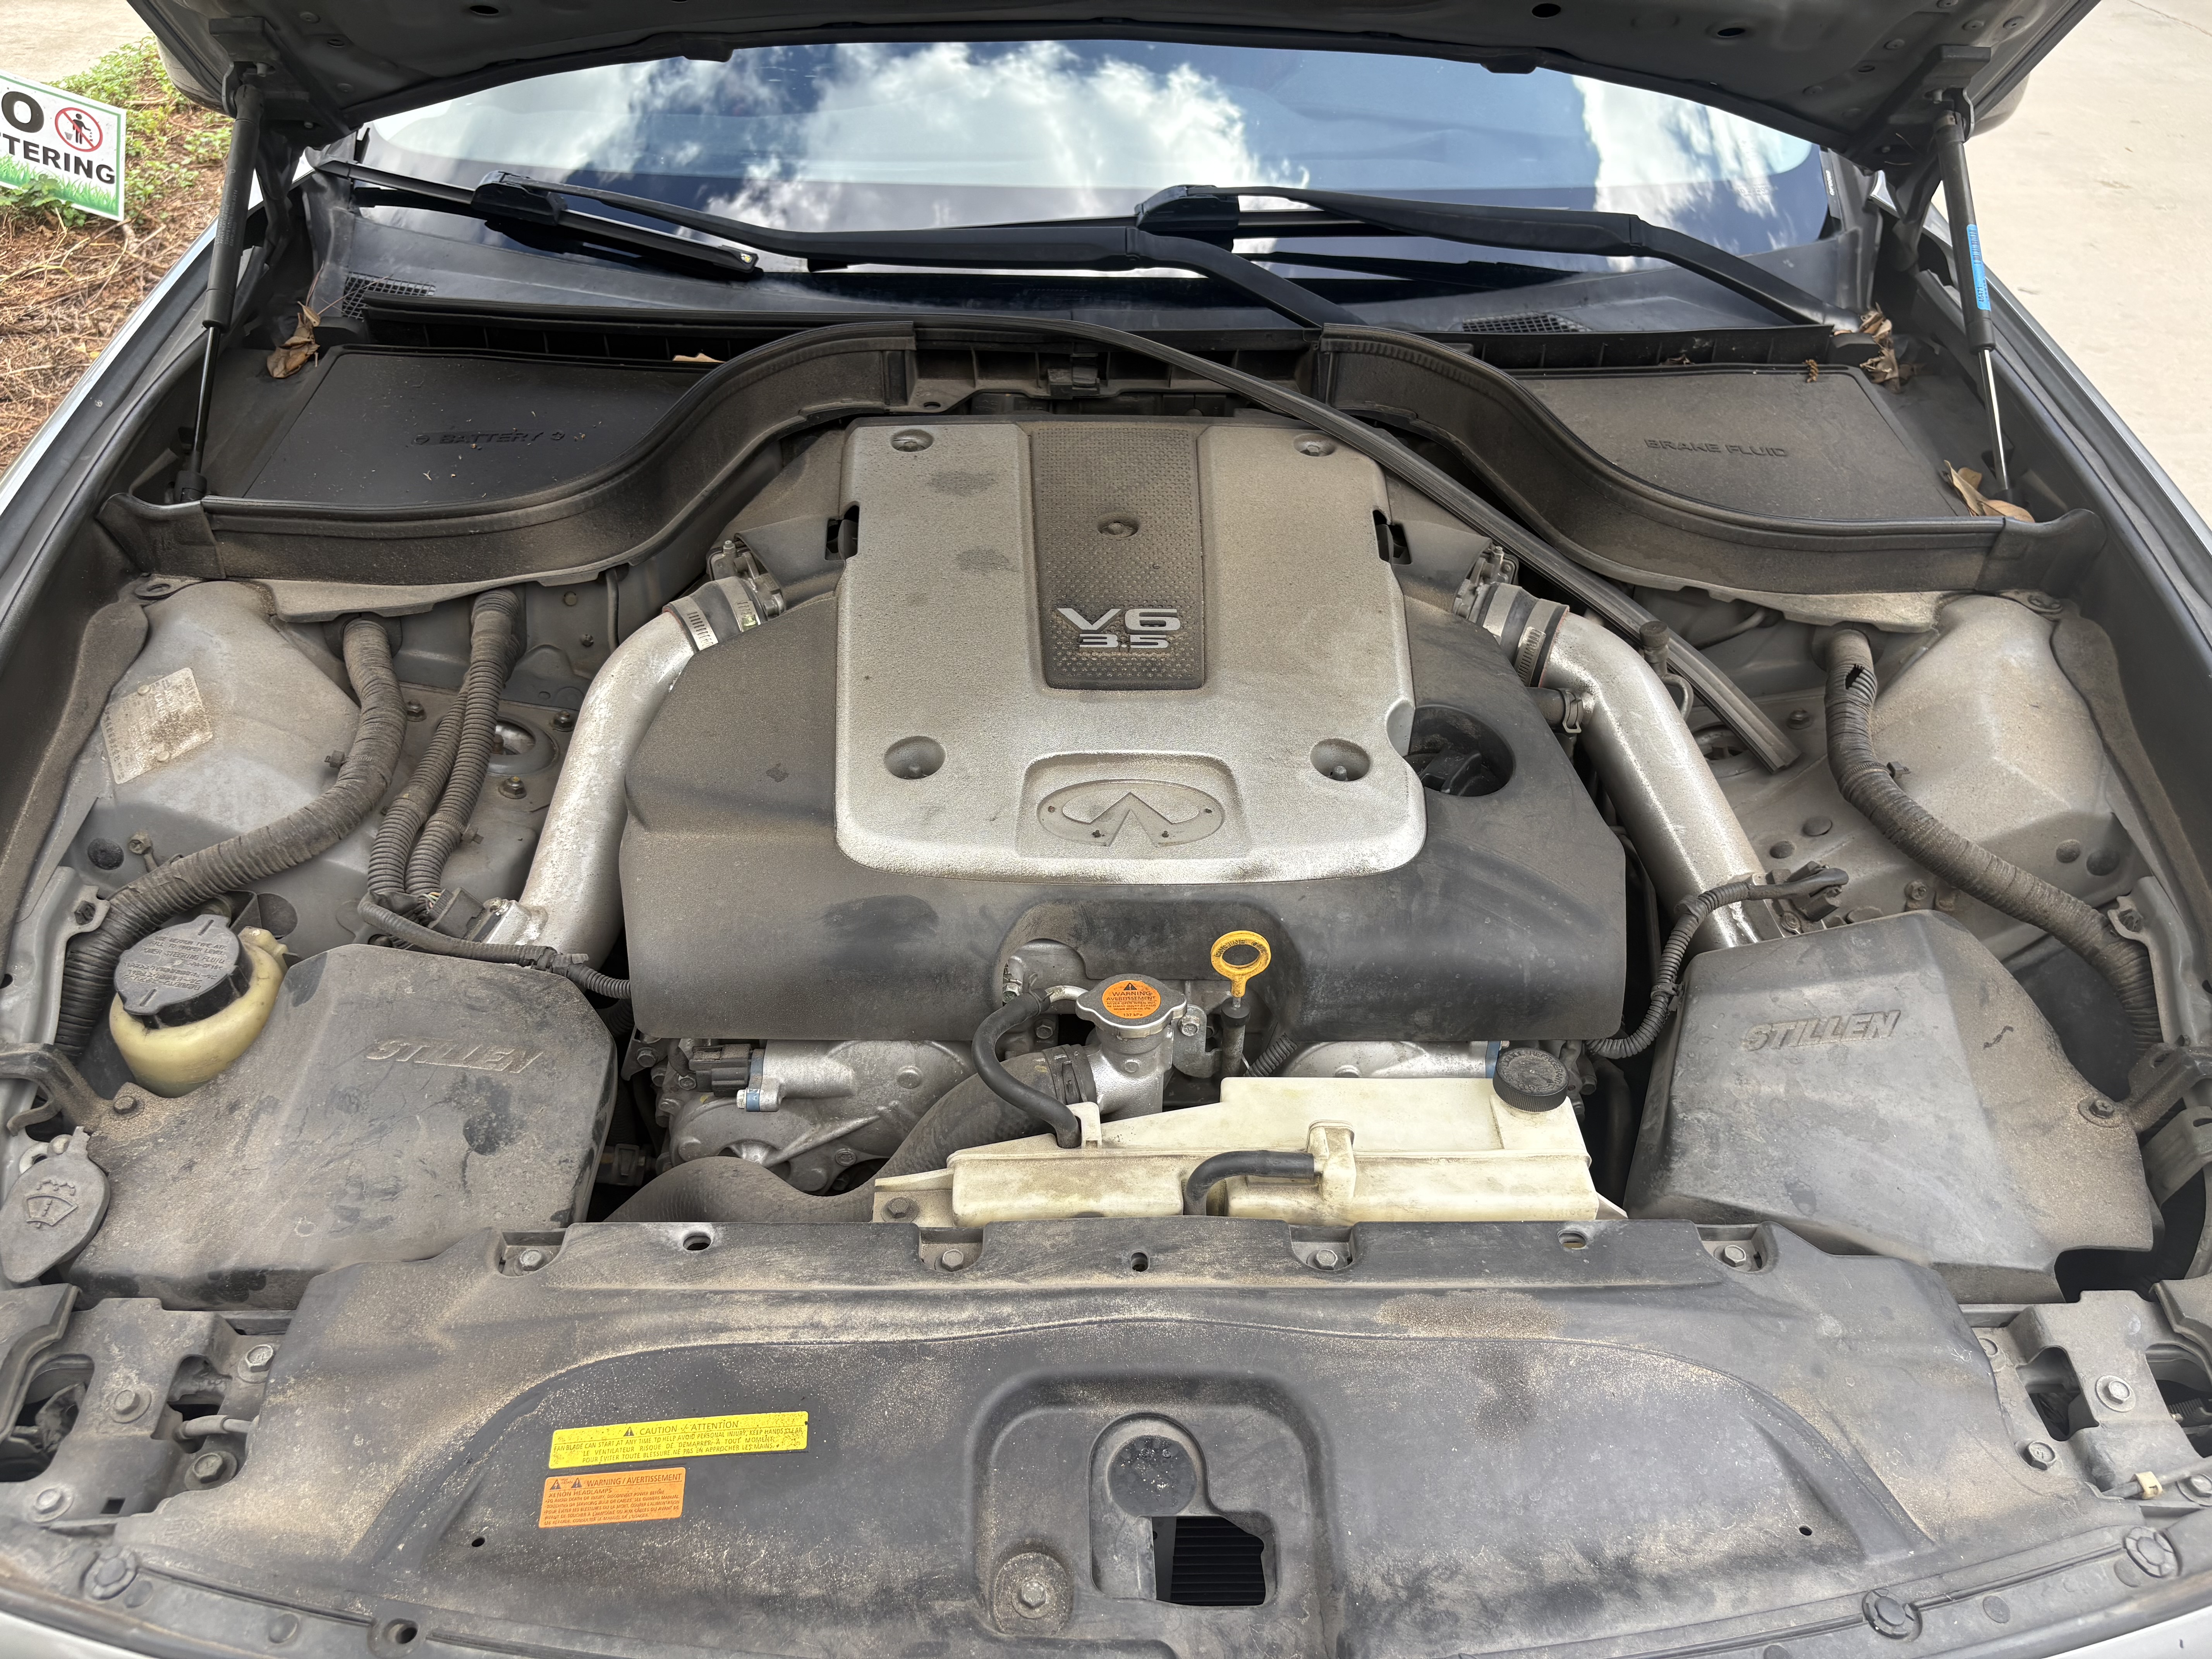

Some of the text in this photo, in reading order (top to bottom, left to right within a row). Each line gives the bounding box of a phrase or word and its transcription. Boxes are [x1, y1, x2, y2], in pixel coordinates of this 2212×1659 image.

[0, 132, 115, 185] TERING
[439, 431, 544, 444] BATTERY
[1644, 438, 1790, 457] BRAKE FLUID
[1057, 608, 1181, 632] V6
[1079, 634, 1169, 649] 3.5
[164, 951, 198, 960] STEERING
[1214, 939, 1246, 957] ENGINE
[1740, 1009, 1901, 1052] STILLEN
[639, 1425, 677, 1435] CAUTION
[690, 1420, 739, 1431] ATTENTION
[697, 1431, 725, 1439] PERSONAL
[594, 1446, 634, 1455] VENTILATEUR
[705, 1444, 739, 1453] APPROCHER
[586, 1477, 621, 1487] WARNING
[626, 1473, 682, 1484] AVERTISSEMENT
